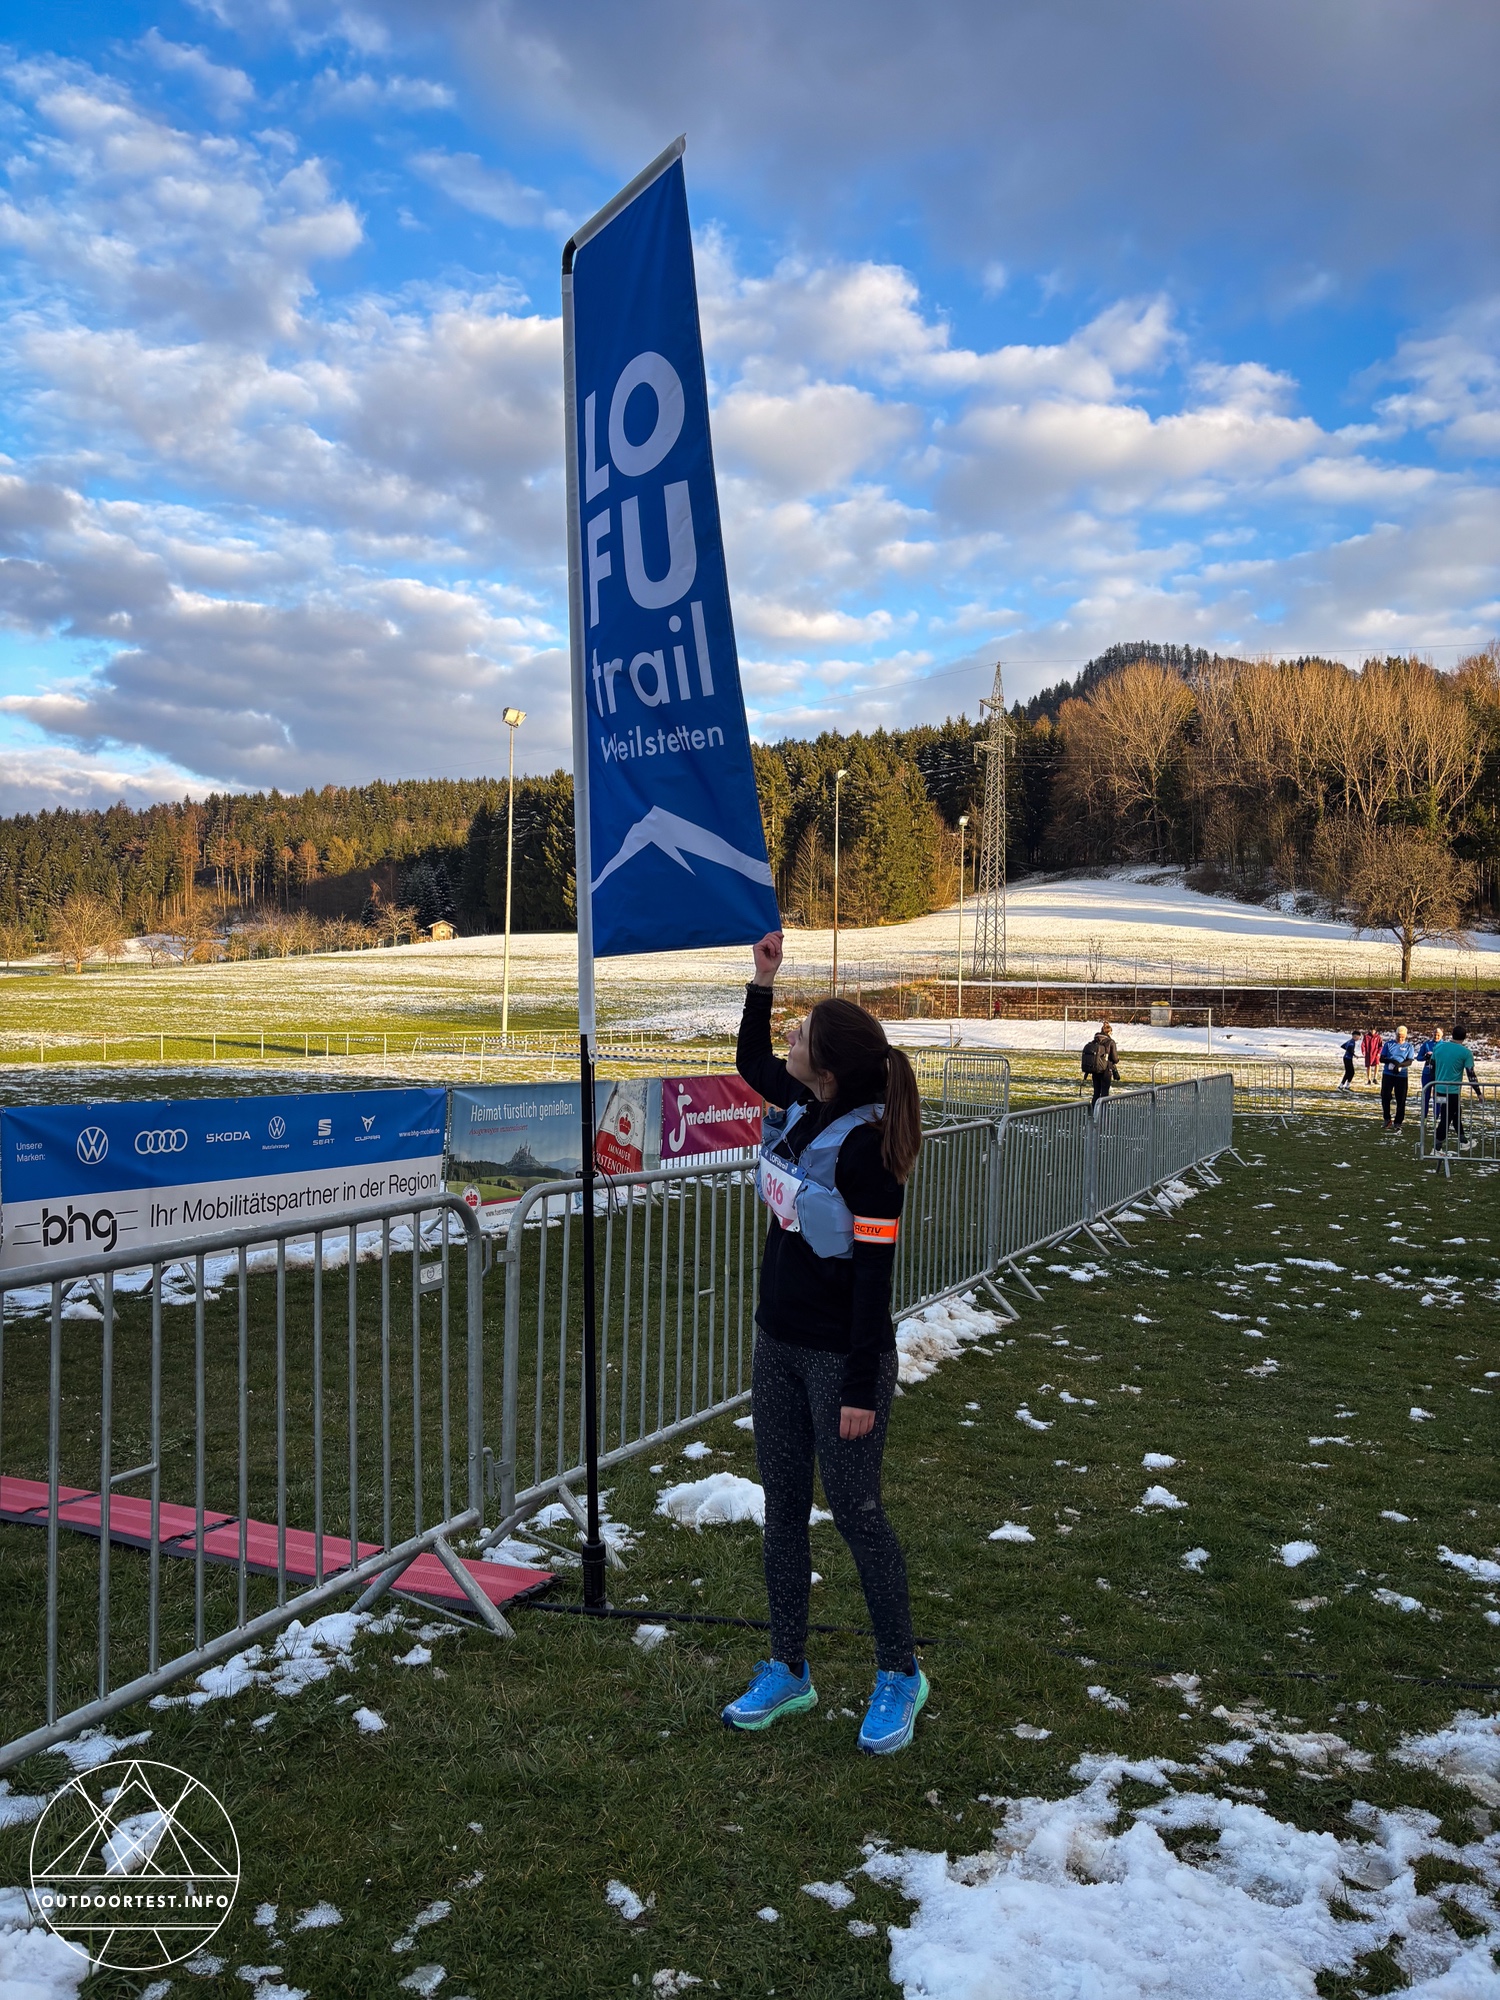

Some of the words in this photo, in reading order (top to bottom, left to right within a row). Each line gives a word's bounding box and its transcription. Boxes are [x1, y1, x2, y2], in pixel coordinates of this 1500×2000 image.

[585, 351, 685, 503] LO
[587, 480, 697, 628] FU
[592, 600, 714, 718] trail
[601, 725, 725, 763] Weilstetten
[471, 1104, 502, 1122] Heimat
[503, 1101, 538, 1120] fürstlich
[539, 1099, 575, 1121] genießen.
[686, 1101, 760, 1125] mediendesign
[16, 1142, 43, 1151] Unsere
[16, 1154, 46, 1162] Marken:
[150, 1203, 178, 1228] Ihr
[183, 1186, 339, 1223] Mobilitätspartner
[343, 1181, 356, 1201] in
[360, 1178, 385, 1199] der
[766, 1173, 784, 1205] 316
[41, 1204, 118, 1253] bhg
